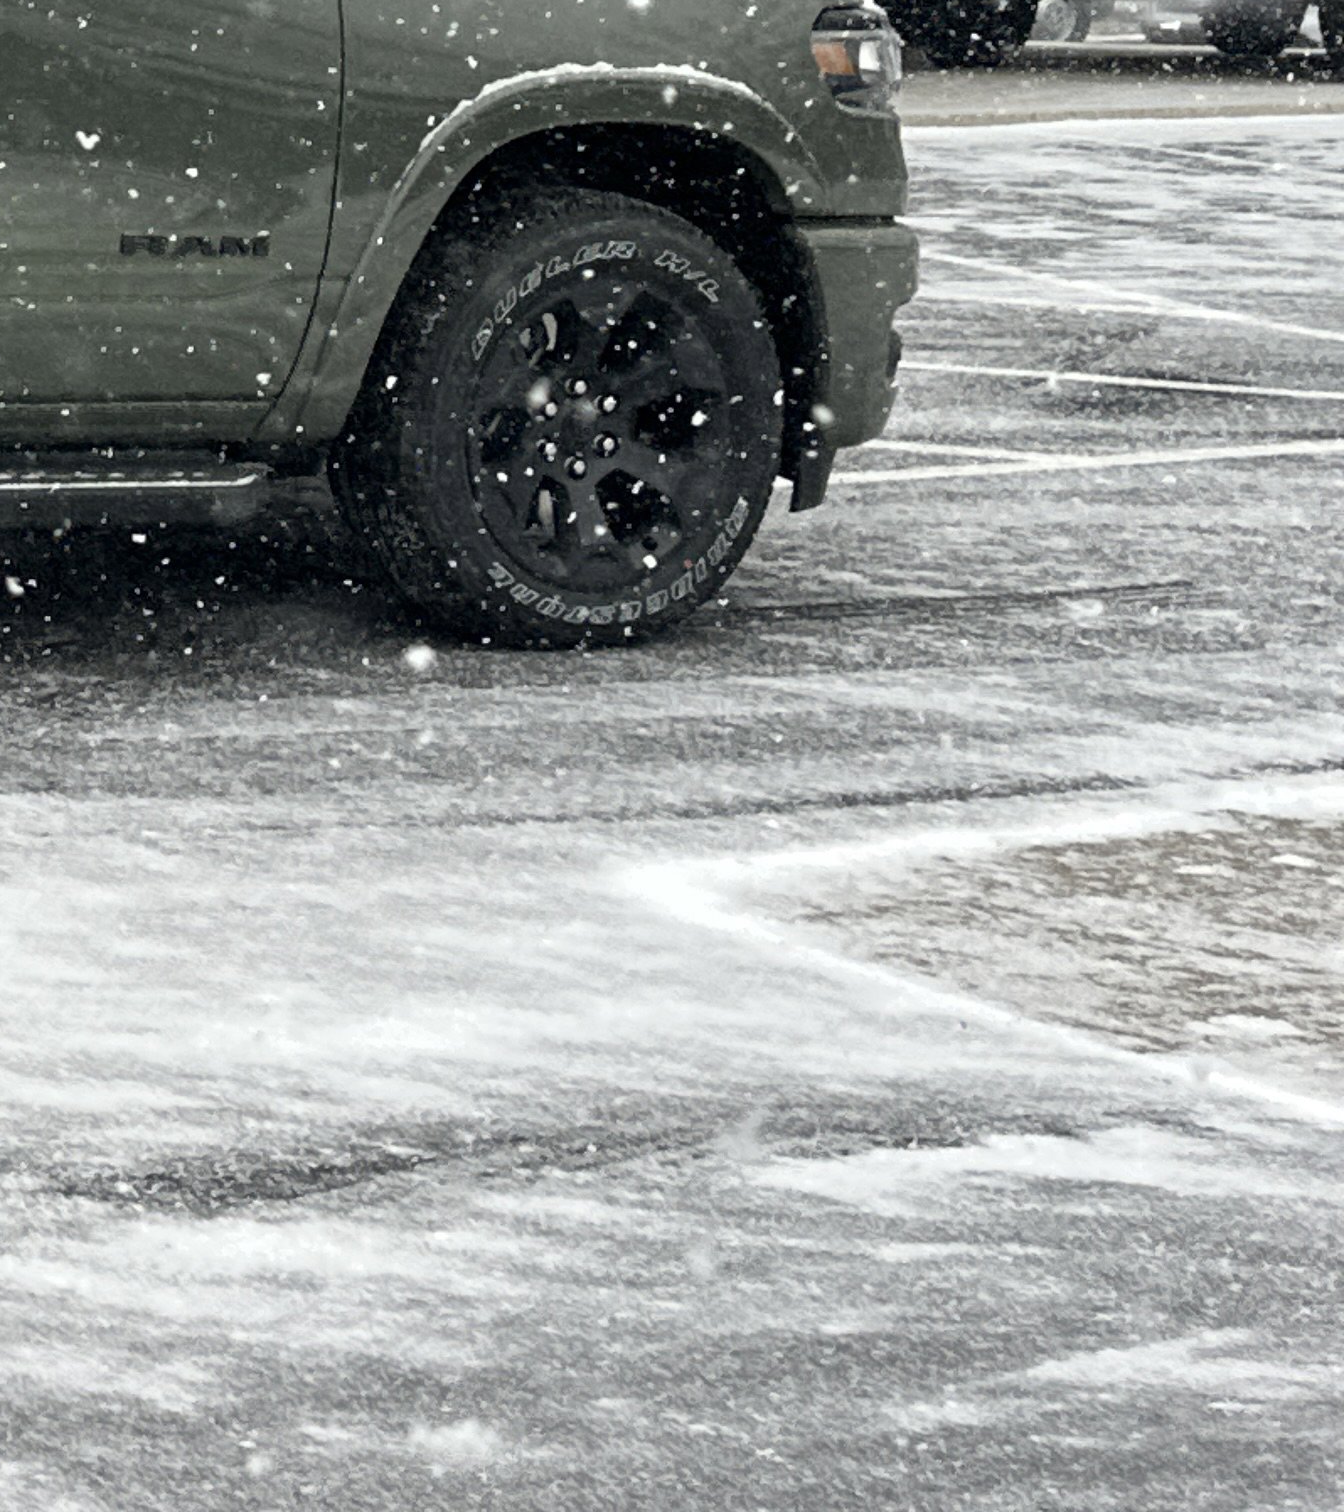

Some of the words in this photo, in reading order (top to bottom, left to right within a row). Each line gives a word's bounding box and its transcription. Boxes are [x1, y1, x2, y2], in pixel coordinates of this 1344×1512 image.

[119, 234, 271, 258] RAM
[470, 239, 637, 362] DUELER
[487, 496, 750, 625] BRIDGESTONE
